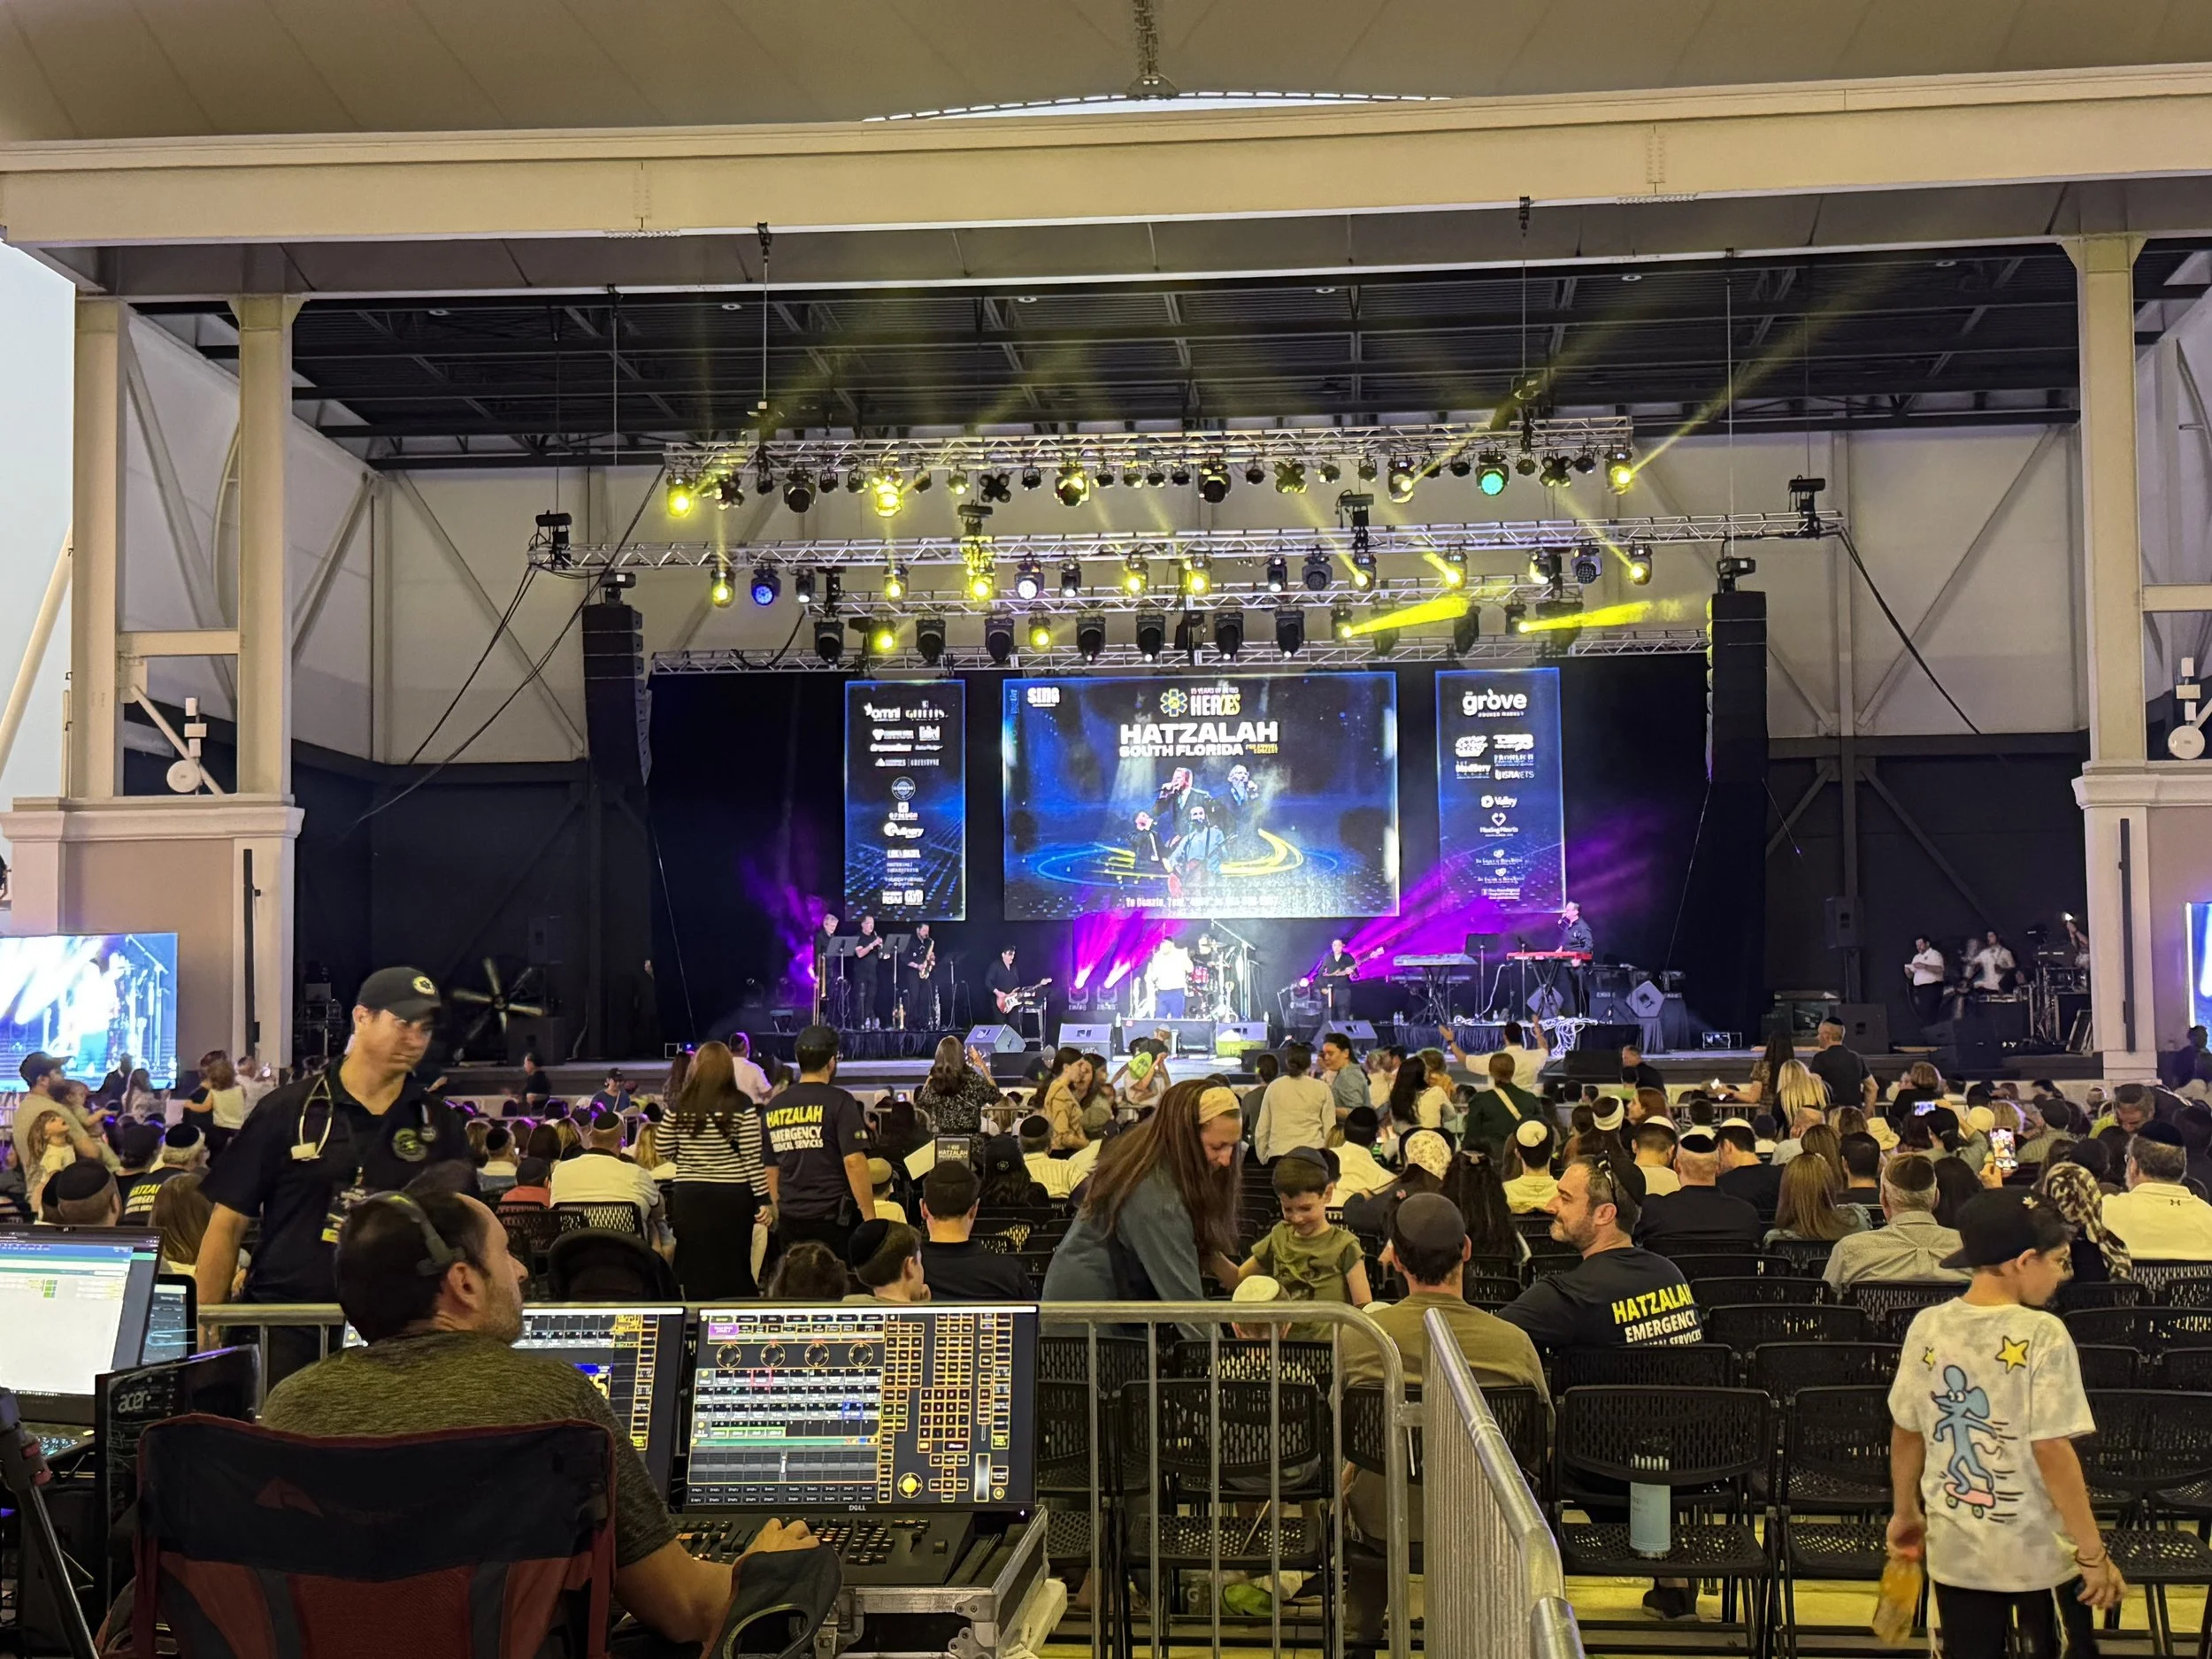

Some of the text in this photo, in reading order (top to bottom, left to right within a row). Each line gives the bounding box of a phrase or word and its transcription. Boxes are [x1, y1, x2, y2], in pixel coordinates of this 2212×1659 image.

[1190, 694, 1241, 716] HEROES
[1120, 721, 1279, 744] HATZALAH
[1119, 744, 1174, 757] SOUTH
[1175, 743, 1244, 757] FLORIDA
[766, 1105, 823, 1129] HATZALAH
[1611, 1283, 1694, 1325] HATZALAH
[1624, 1310, 1698, 1344] EMERGENCY
[118, 1390, 149, 1414] acer
